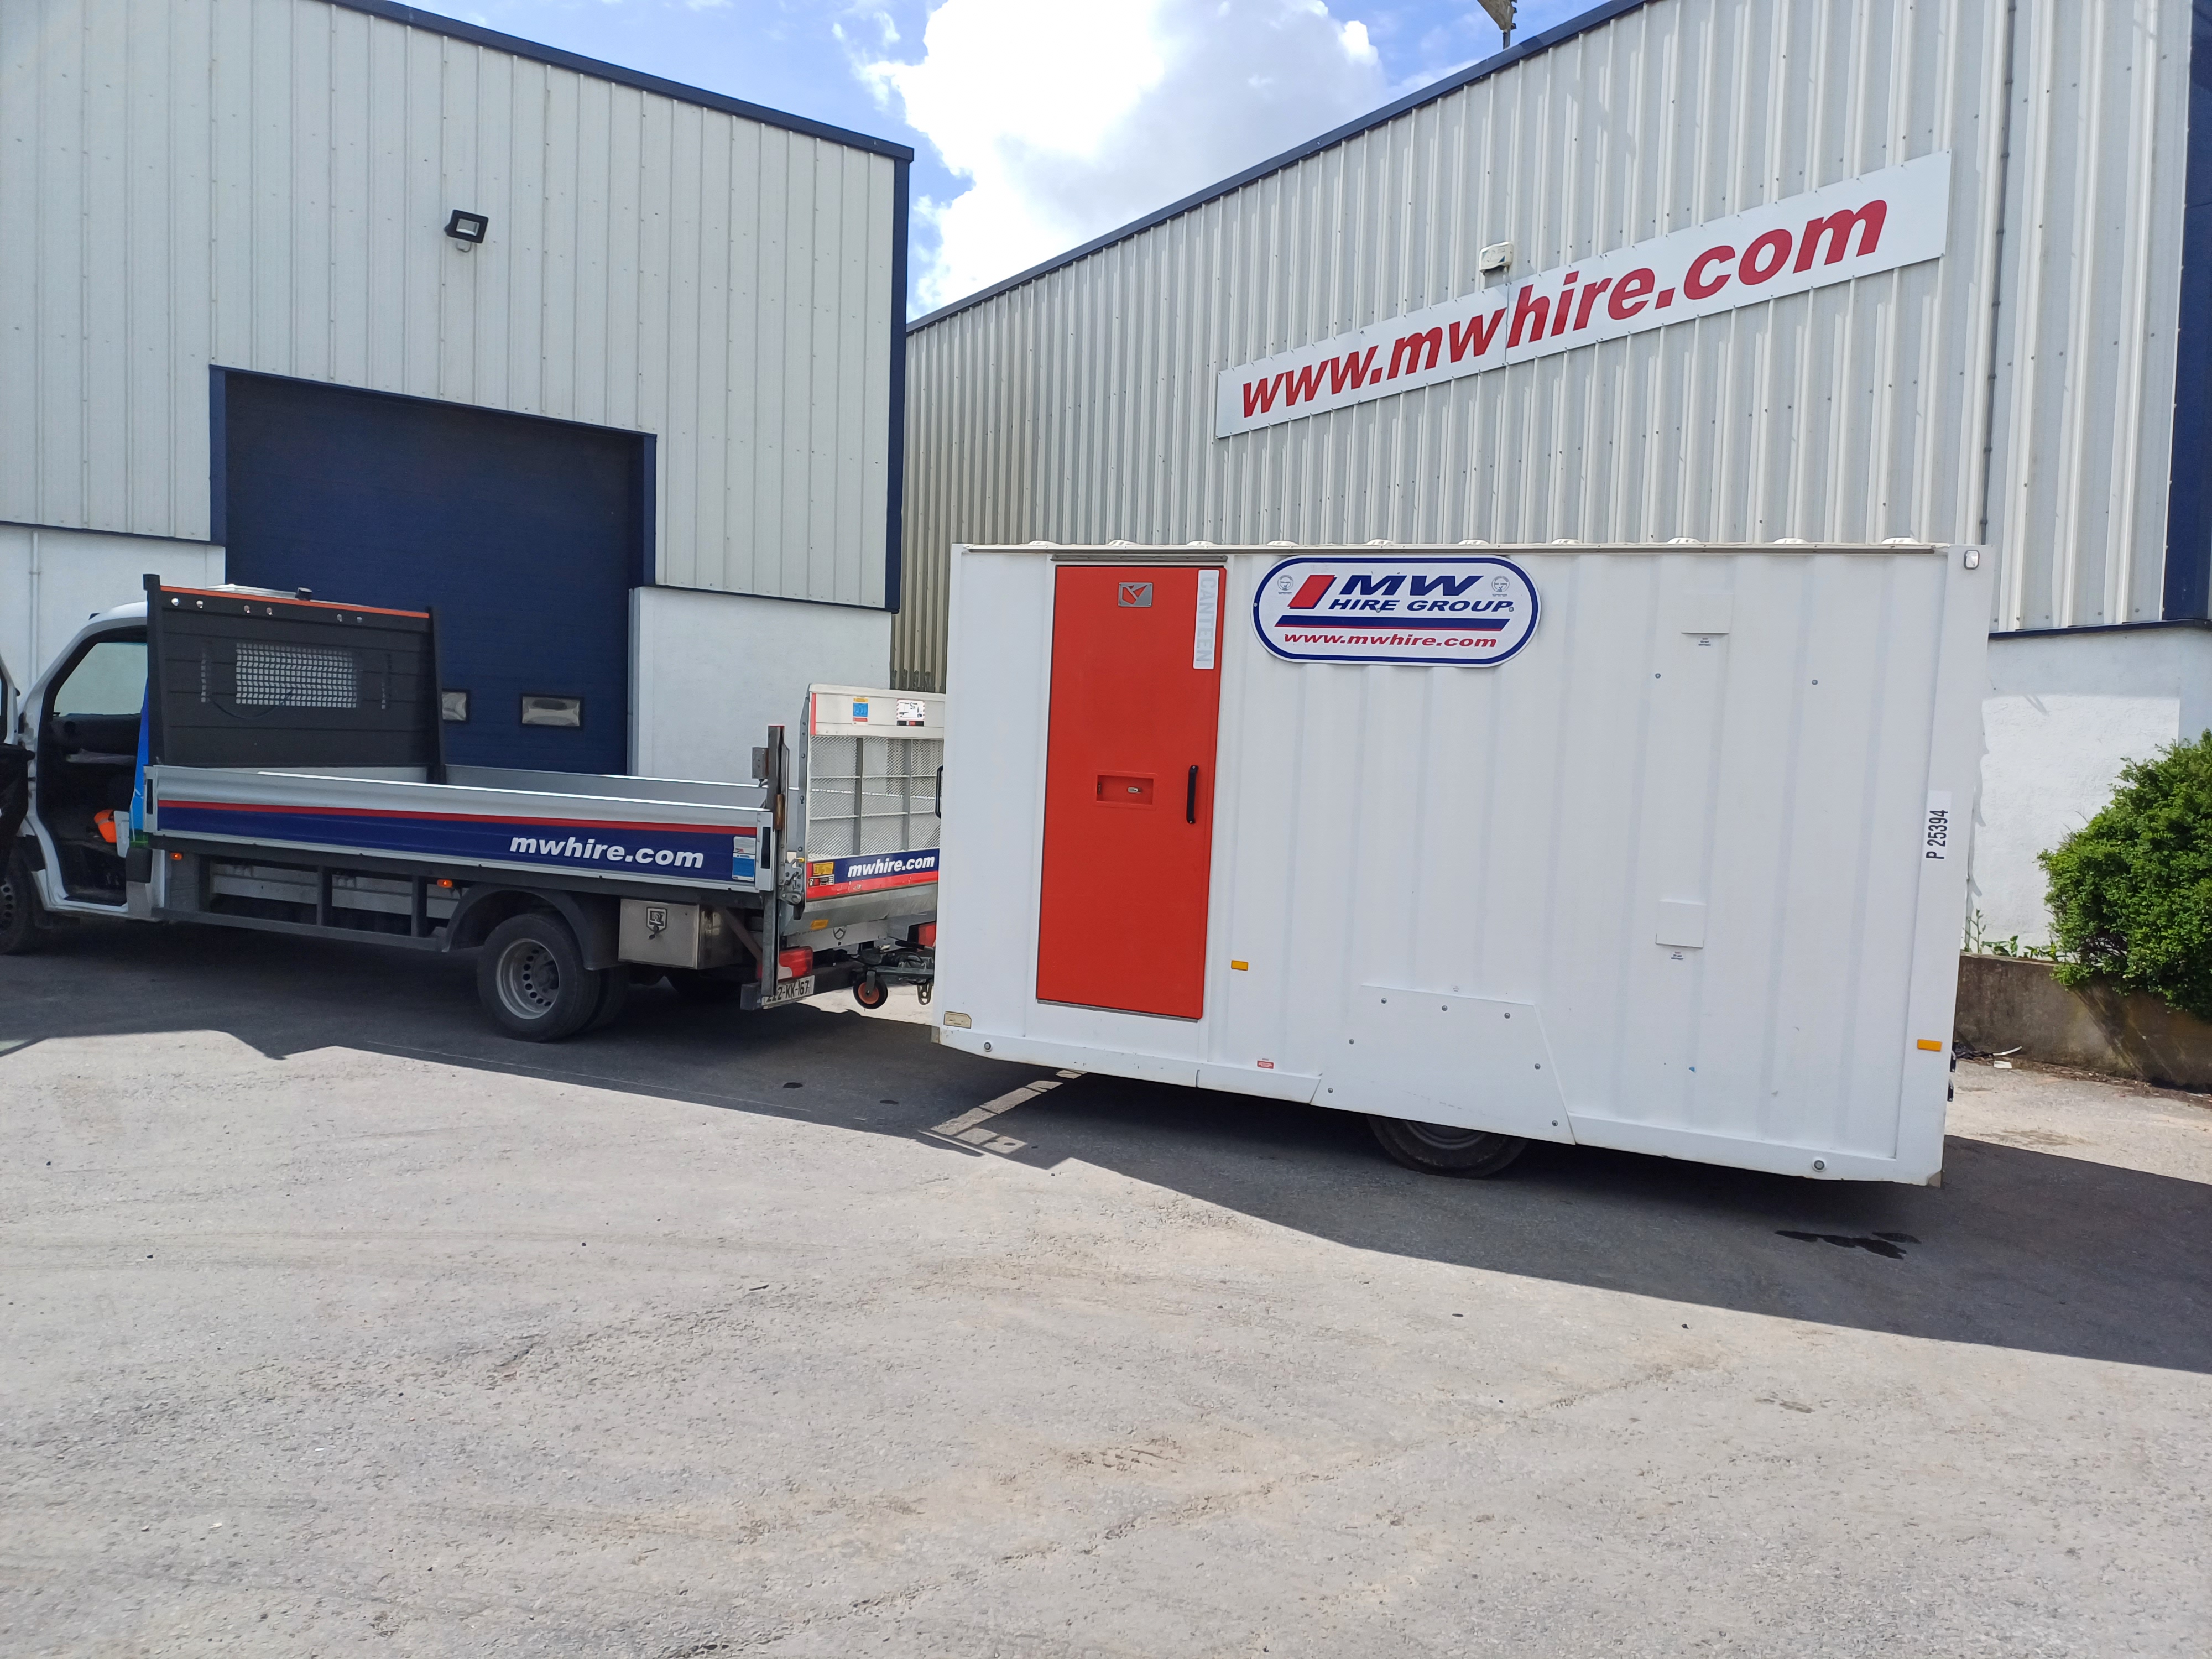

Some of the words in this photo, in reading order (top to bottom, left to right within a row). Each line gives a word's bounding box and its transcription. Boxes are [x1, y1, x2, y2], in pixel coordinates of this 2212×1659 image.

[1243, 200, 1887, 418] www.mwhire.com
[1339, 575, 1484, 596] MW
[1328, 599, 1400, 611] HIRE
[1407, 600, 1514, 612] GROUP
[1196, 577, 1217, 662] CANTEEN
[1284, 634, 1497, 648] www.mwhire.com
[1927, 810, 1948, 847] 25394
[509, 836, 703, 868] mwhire.com
[1926, 851, 1945, 859] P
[847, 856, 935, 878] mwhire.com
